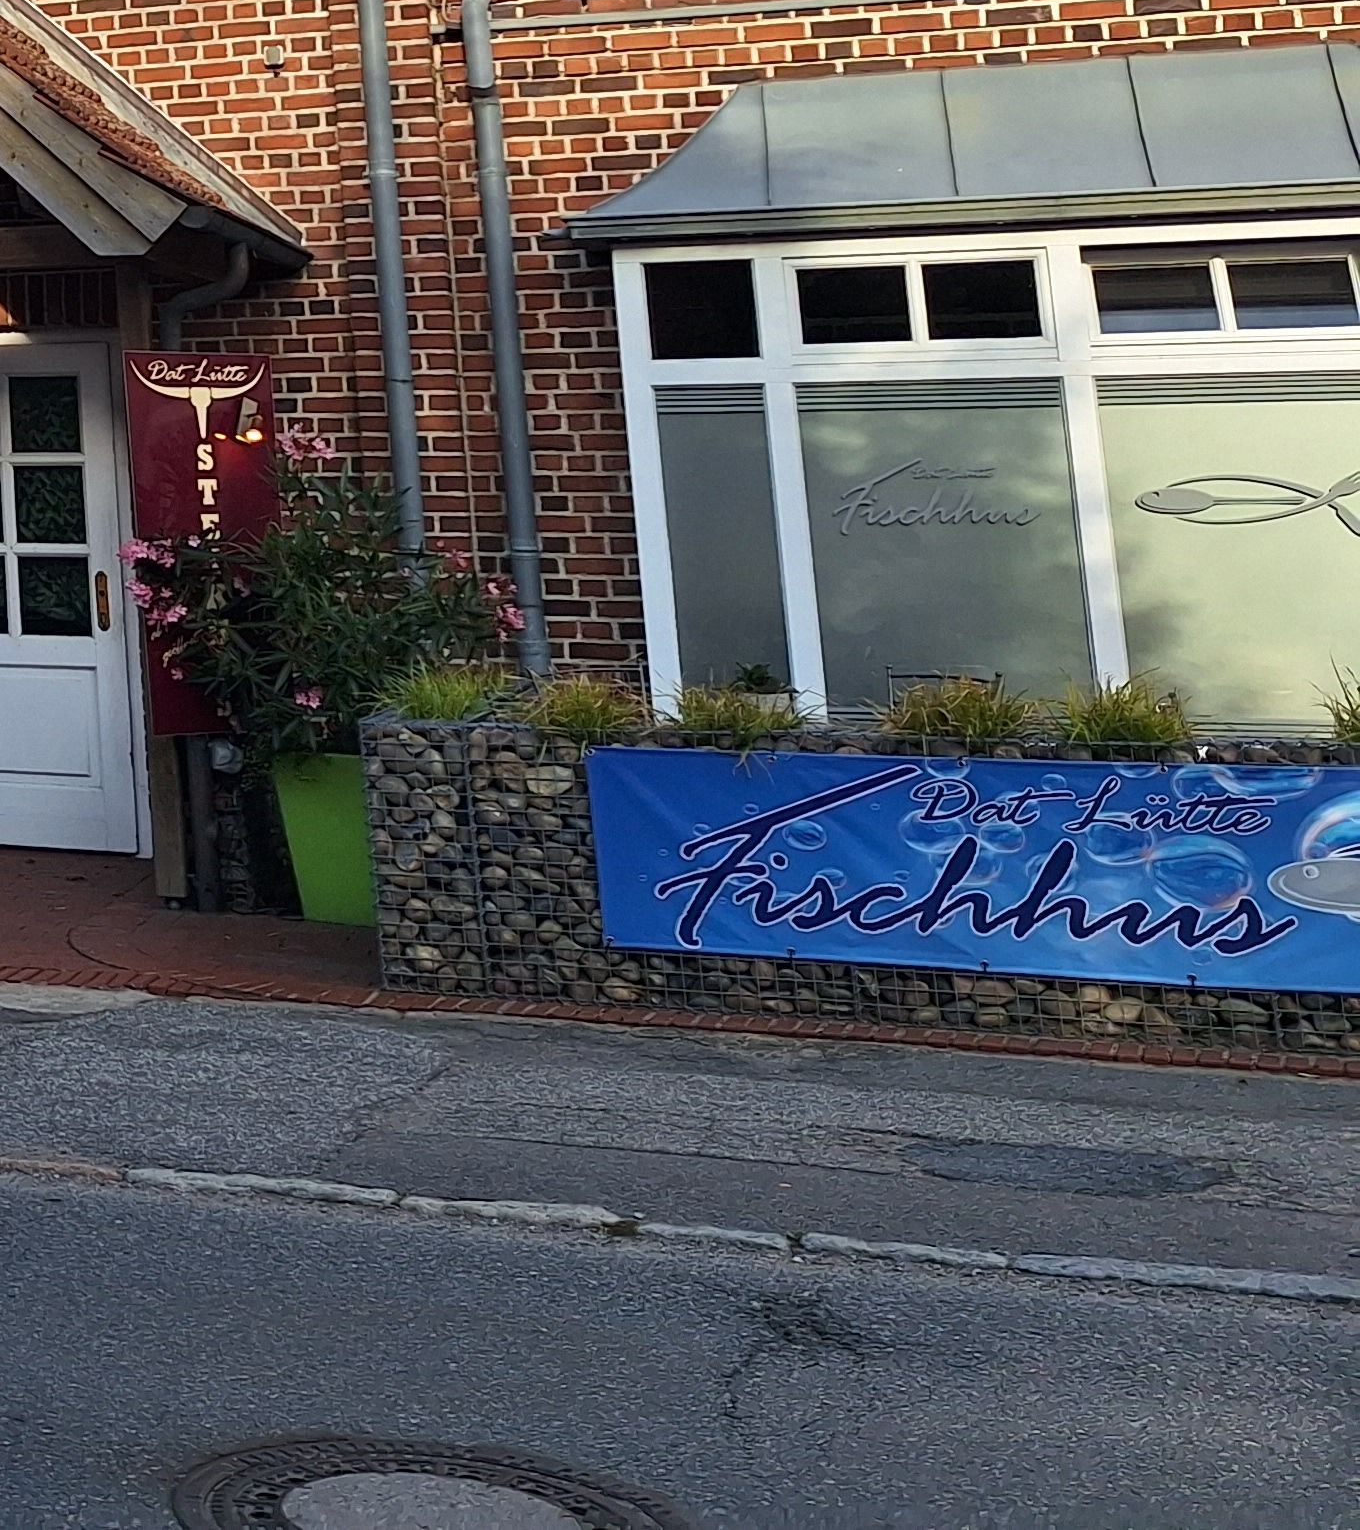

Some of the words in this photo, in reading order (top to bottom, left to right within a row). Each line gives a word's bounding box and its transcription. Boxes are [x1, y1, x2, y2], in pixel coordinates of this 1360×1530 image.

[147, 359, 195, 381] Dat
[191, 358, 249, 383] Lütte
[832, 457, 1042, 537] Fischhus
[910, 776, 1075, 824] Dat
[1061, 774, 1278, 836] Lütte
[654, 764, 1298, 958] Fischhus
